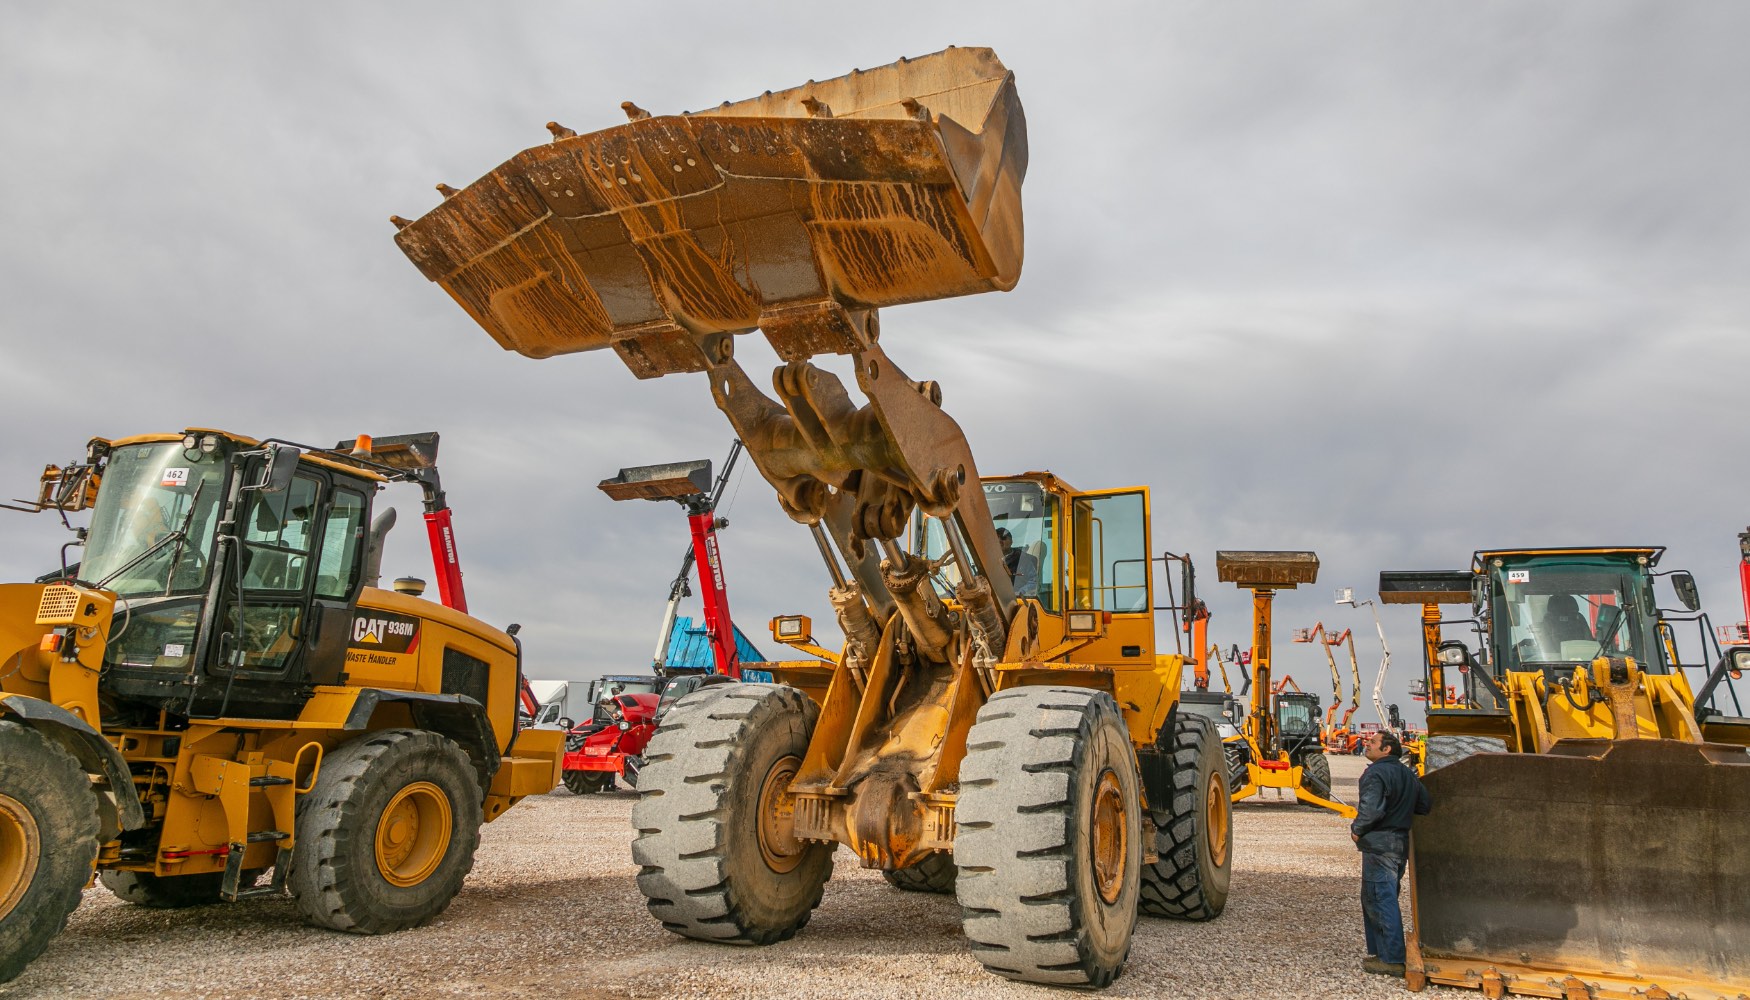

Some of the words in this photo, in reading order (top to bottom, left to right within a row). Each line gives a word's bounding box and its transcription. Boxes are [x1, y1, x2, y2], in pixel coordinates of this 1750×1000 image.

[166, 470, 183, 479] 462
[443, 526, 456, 564] MANITOU
[353, 617, 388, 643] CAT
[388, 621, 414, 636] 938M
[368, 653, 397, 665] HANDLER
